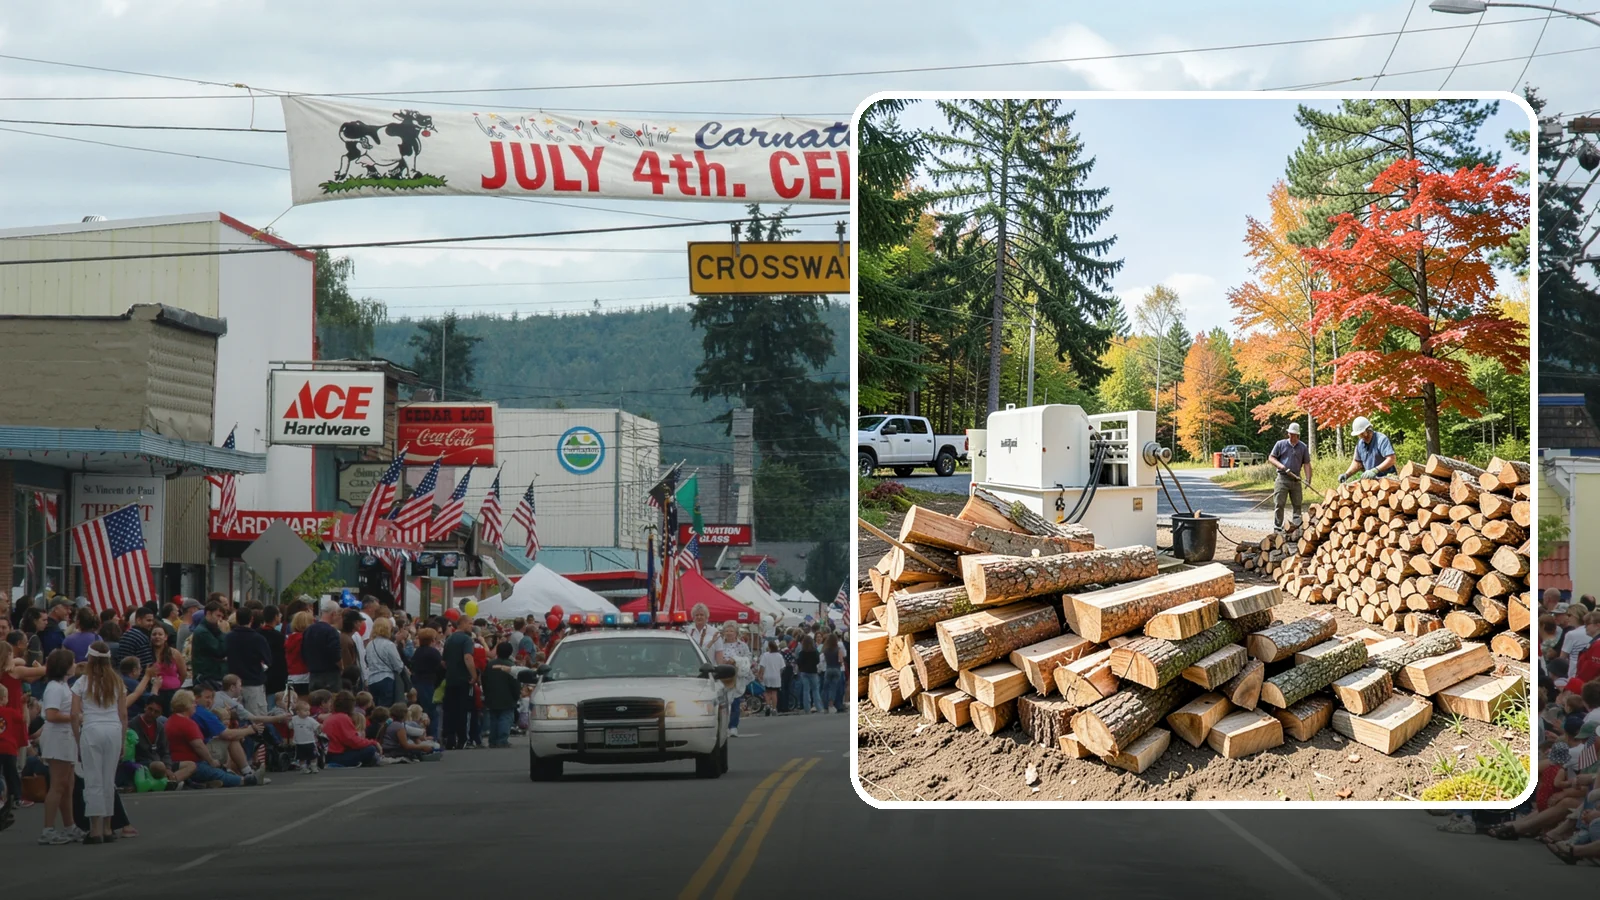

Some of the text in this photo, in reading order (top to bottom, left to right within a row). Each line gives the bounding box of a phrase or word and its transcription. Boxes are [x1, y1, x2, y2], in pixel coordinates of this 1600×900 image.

[481, 140, 605, 192] JULY
[632, 150, 747, 197] 4th.
[697, 254, 850, 280] CROSSWA
[283, 380, 373, 420] ACE
[405, 409, 452, 422] CEDAR
[284, 421, 370, 436] Hardware
[416, 428, 477, 447] Coca-Cola
[83, 485, 155, 495] St. Vincent de Paul
[212, 516, 331, 535] HARDARE
[688, 526, 741, 535] CRNATION
[699, 535, 730, 543] GLASS
